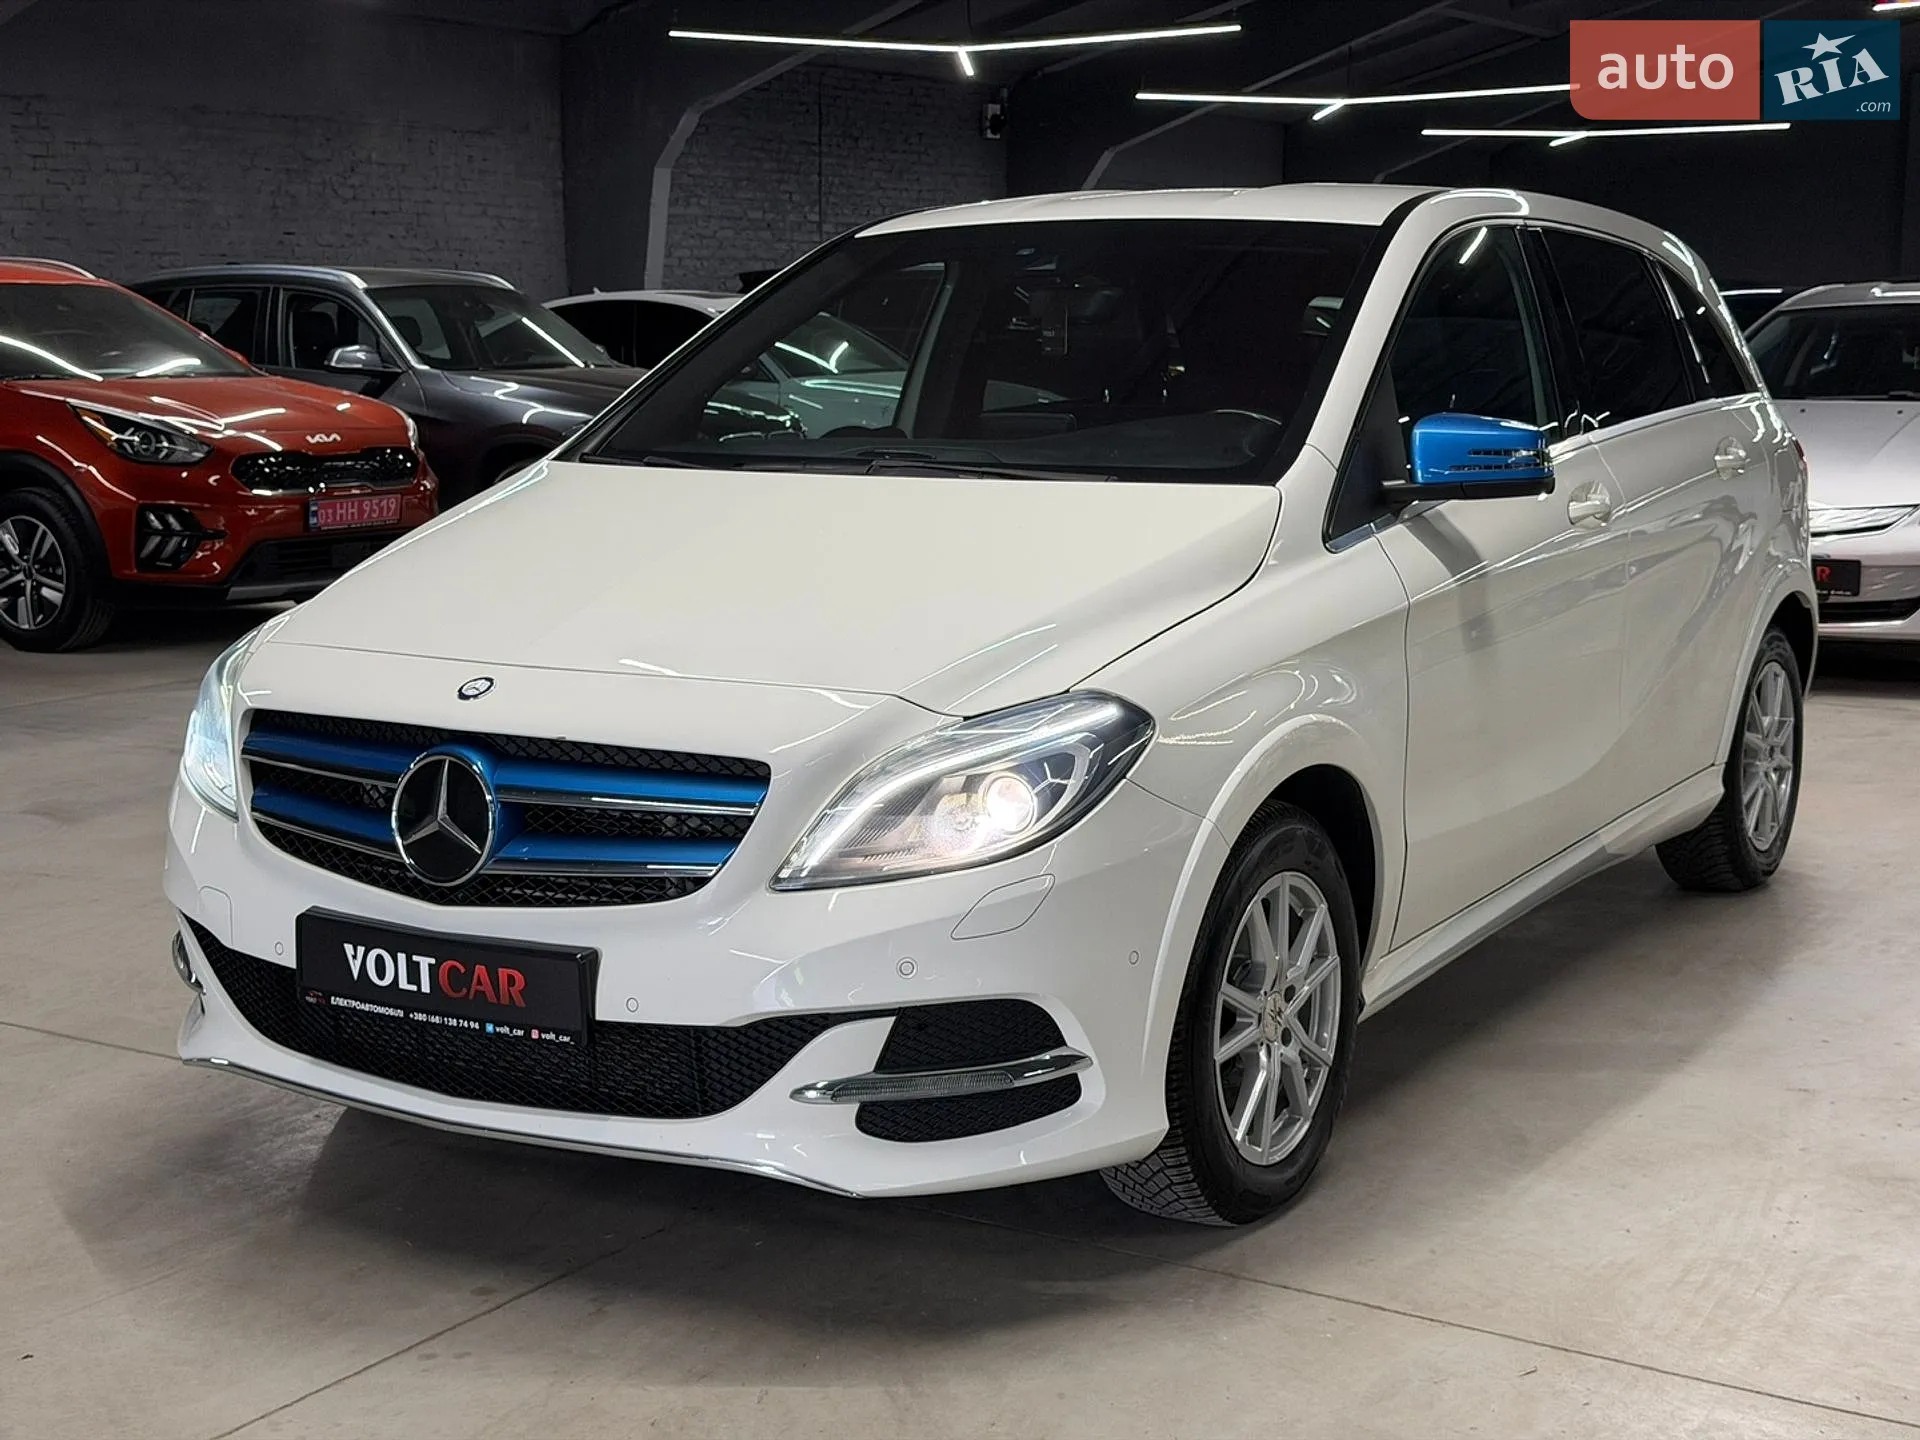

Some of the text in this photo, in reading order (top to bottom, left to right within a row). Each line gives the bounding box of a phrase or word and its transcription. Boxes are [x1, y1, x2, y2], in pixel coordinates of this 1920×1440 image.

[363, 497, 397, 519] 9519
[343, 943, 526, 1008] VOLTCAR
[495, 1025, 525, 1037] volt_car
